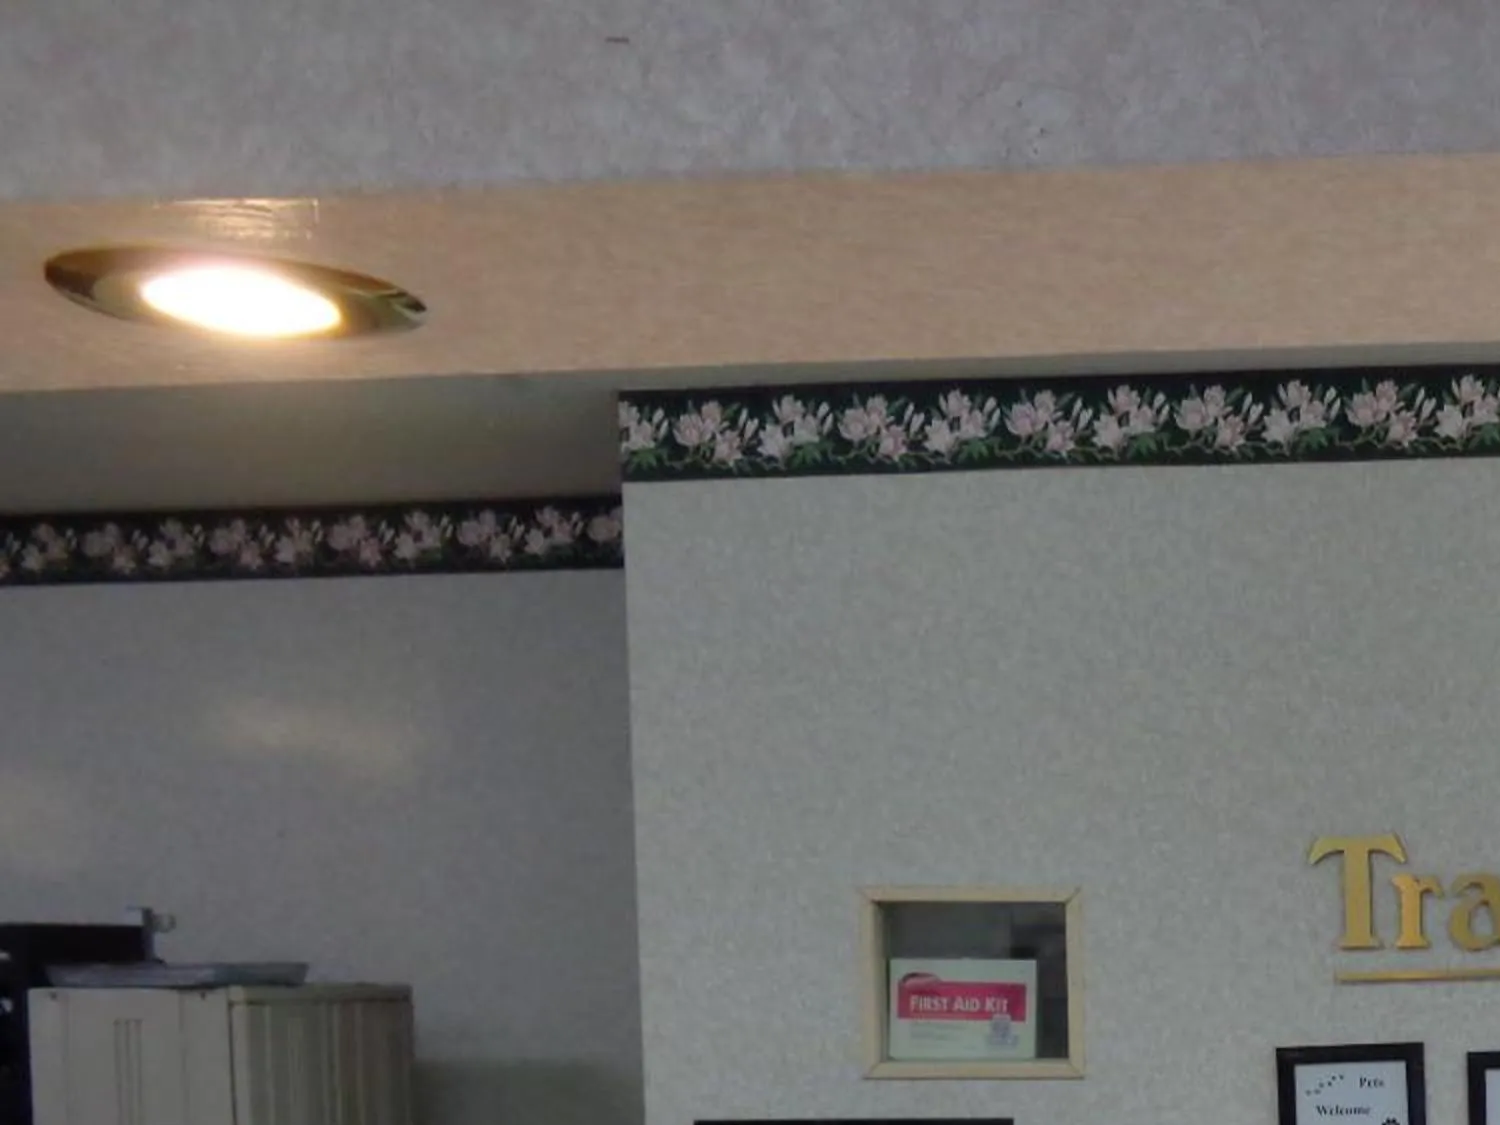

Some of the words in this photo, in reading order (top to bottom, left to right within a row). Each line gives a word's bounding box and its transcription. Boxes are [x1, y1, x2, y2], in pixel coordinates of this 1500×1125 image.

[909, 995, 948, 1012] FIRST
[952, 996, 980, 1012] AID
[985, 997, 1009, 1013] KIT
[1359, 1077, 1385, 1089] Pets
[1316, 1105, 1371, 1116] Welcome
